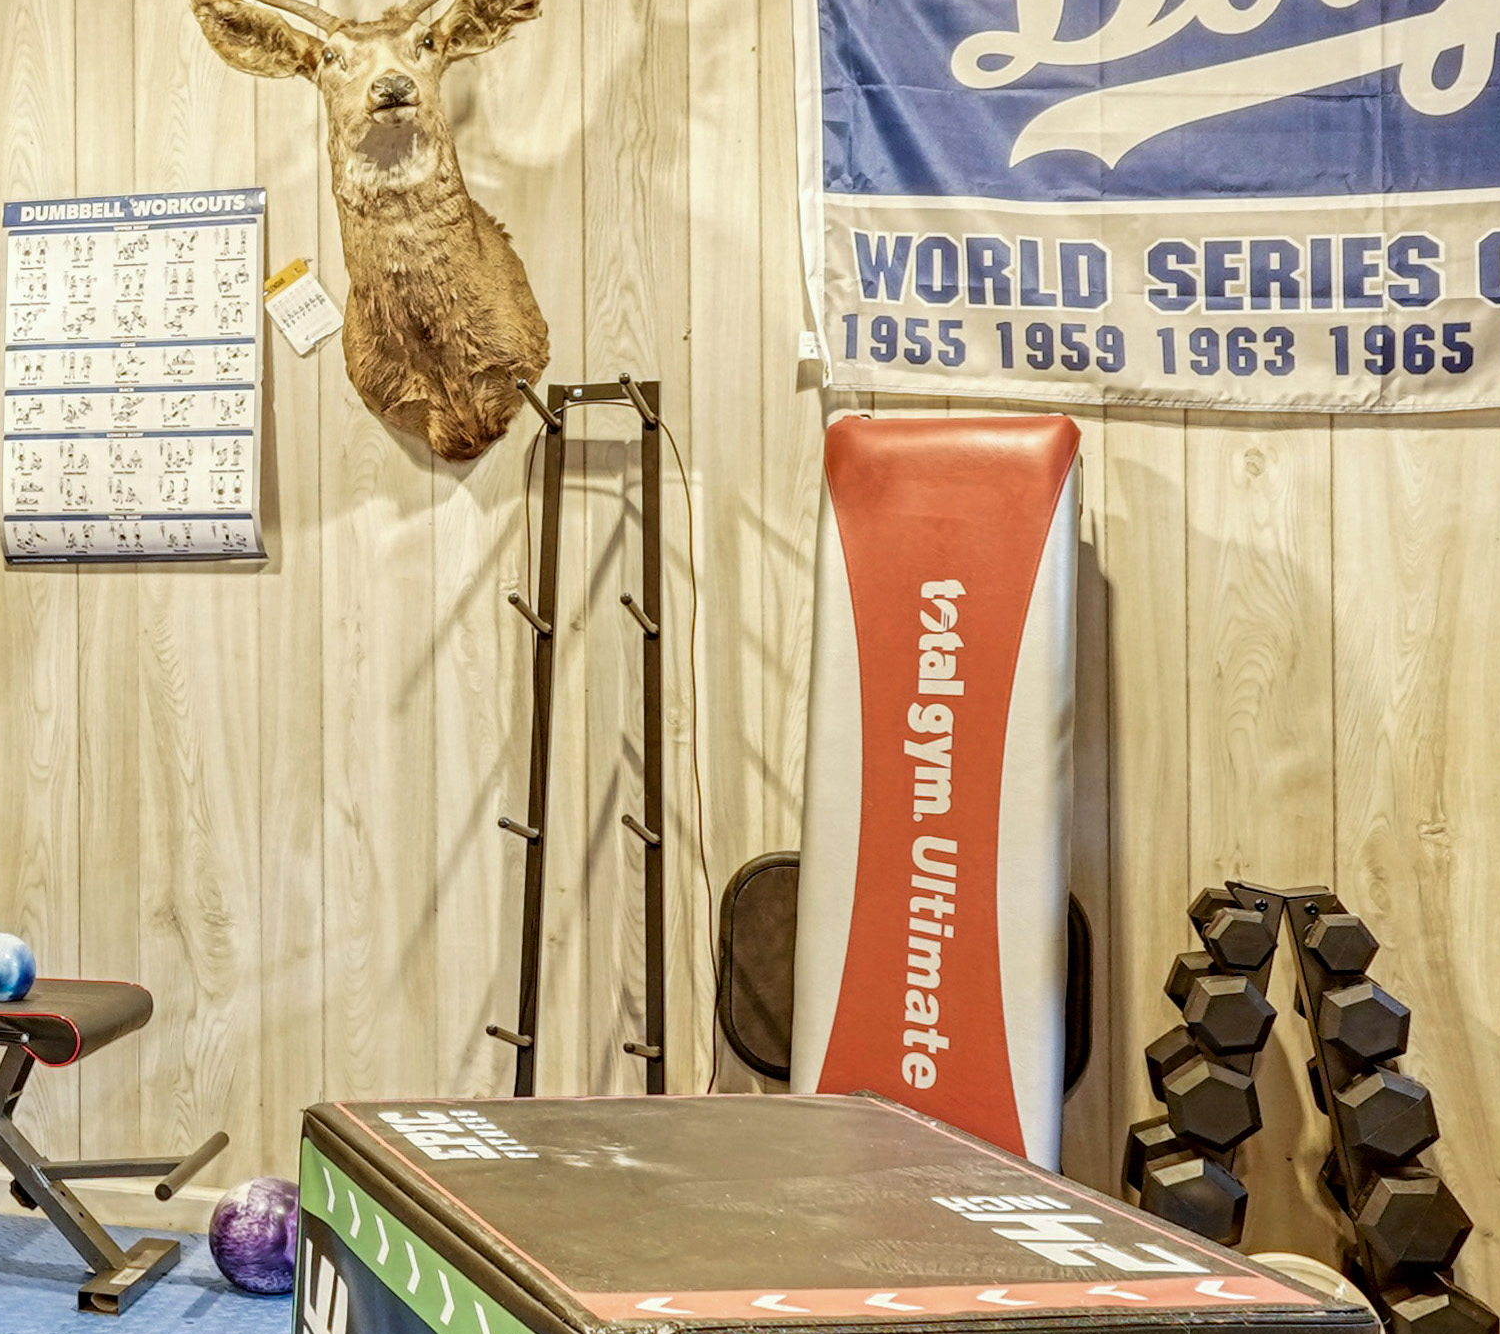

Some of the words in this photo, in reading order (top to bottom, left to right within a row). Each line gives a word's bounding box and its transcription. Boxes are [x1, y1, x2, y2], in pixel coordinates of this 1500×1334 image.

[20, 201, 126, 223] DUMBBELL
[130, 194, 247, 219] WORKOUTS
[851, 228, 1112, 312] WORLD
[1144, 230, 1447, 314] SERIES
[841, 311, 966, 367] 1955
[996, 320, 1126, 372] 1959
[1156, 325, 1296, 377] 1963
[1329, 322, 1474, 376] 1965
[918, 579, 968, 696] total
[903, 701, 955, 816] gym
[901, 837, 959, 1091] Ultimate
[377, 1110, 502, 1161] EPIC
[931, 1195, 1071, 1213] INCH
